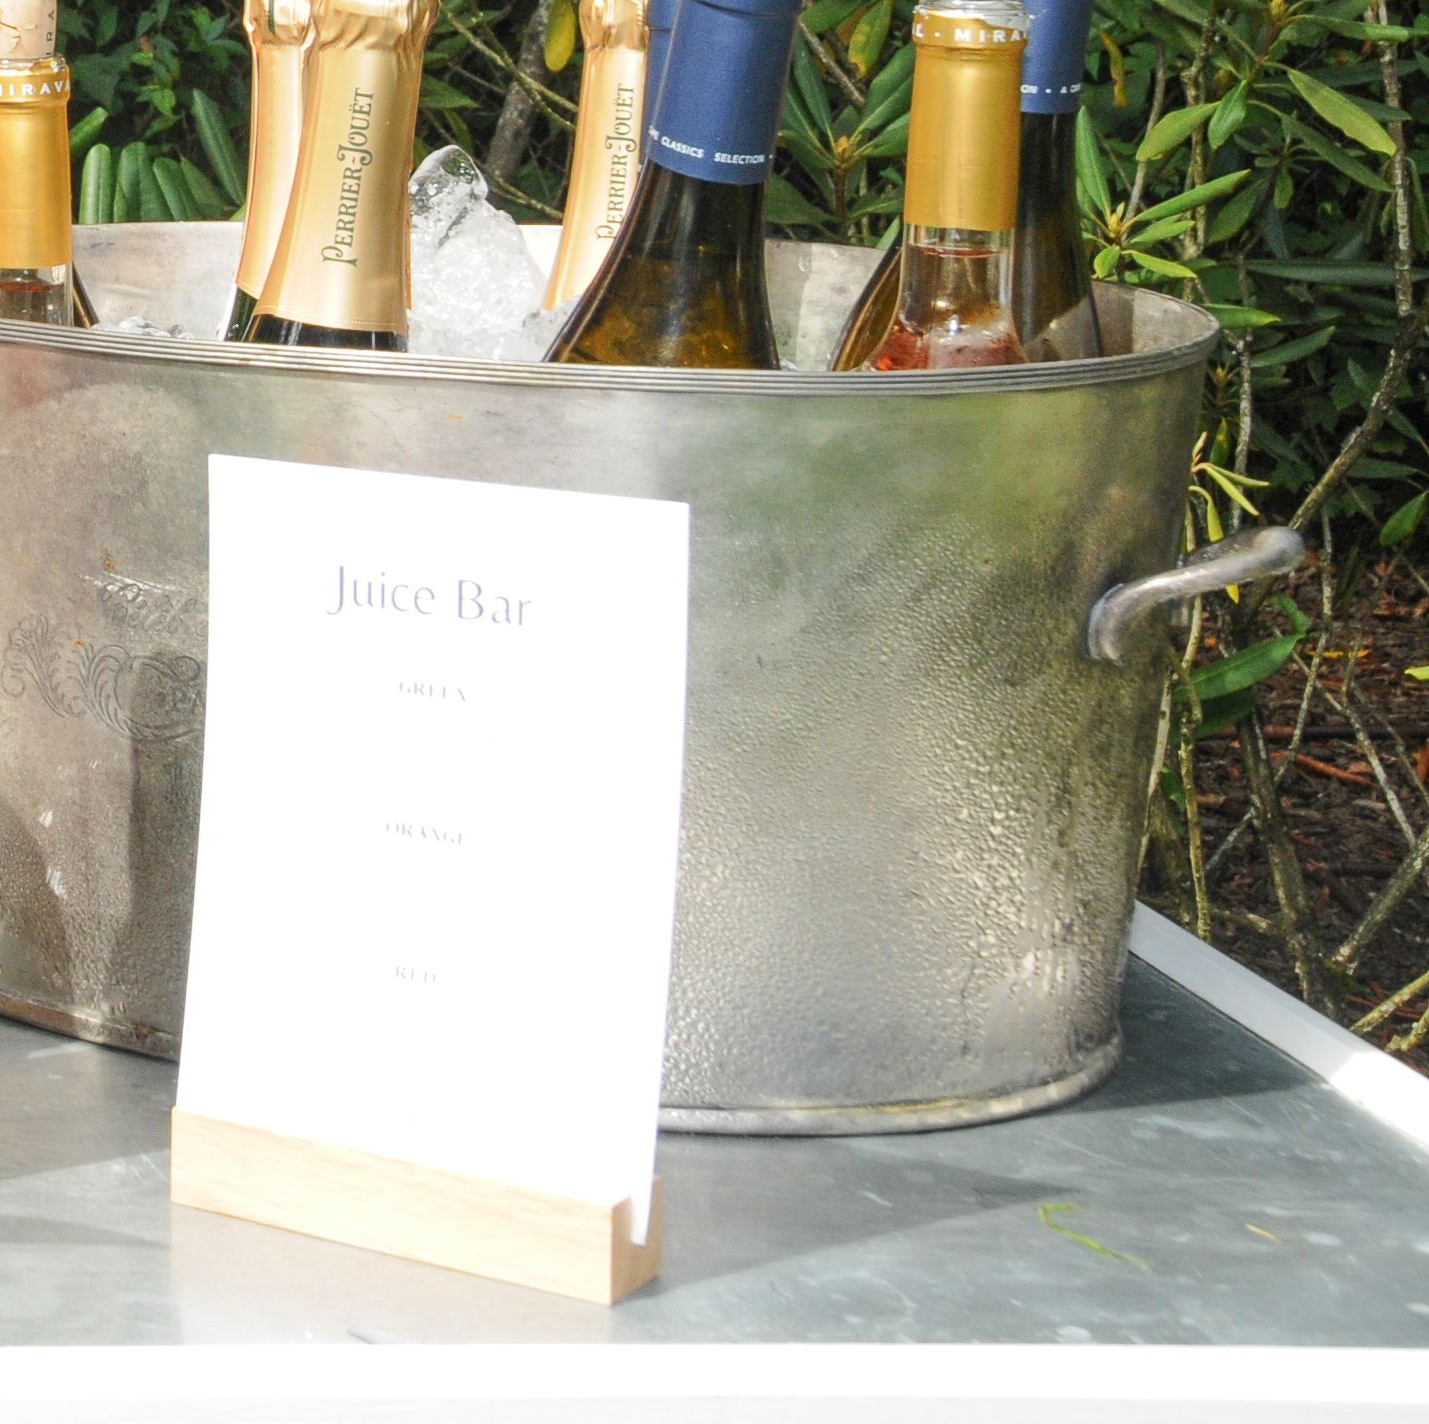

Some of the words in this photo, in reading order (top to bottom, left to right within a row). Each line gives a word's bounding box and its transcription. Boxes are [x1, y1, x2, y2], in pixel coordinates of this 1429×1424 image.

[954, 28, 1026, 43] MIRA
[660, 136, 705, 159] CLASSICS
[714, 152, 765, 165] SELECTION
[326, 565, 436, 616] Juice
[457, 579, 533, 627] Bar
